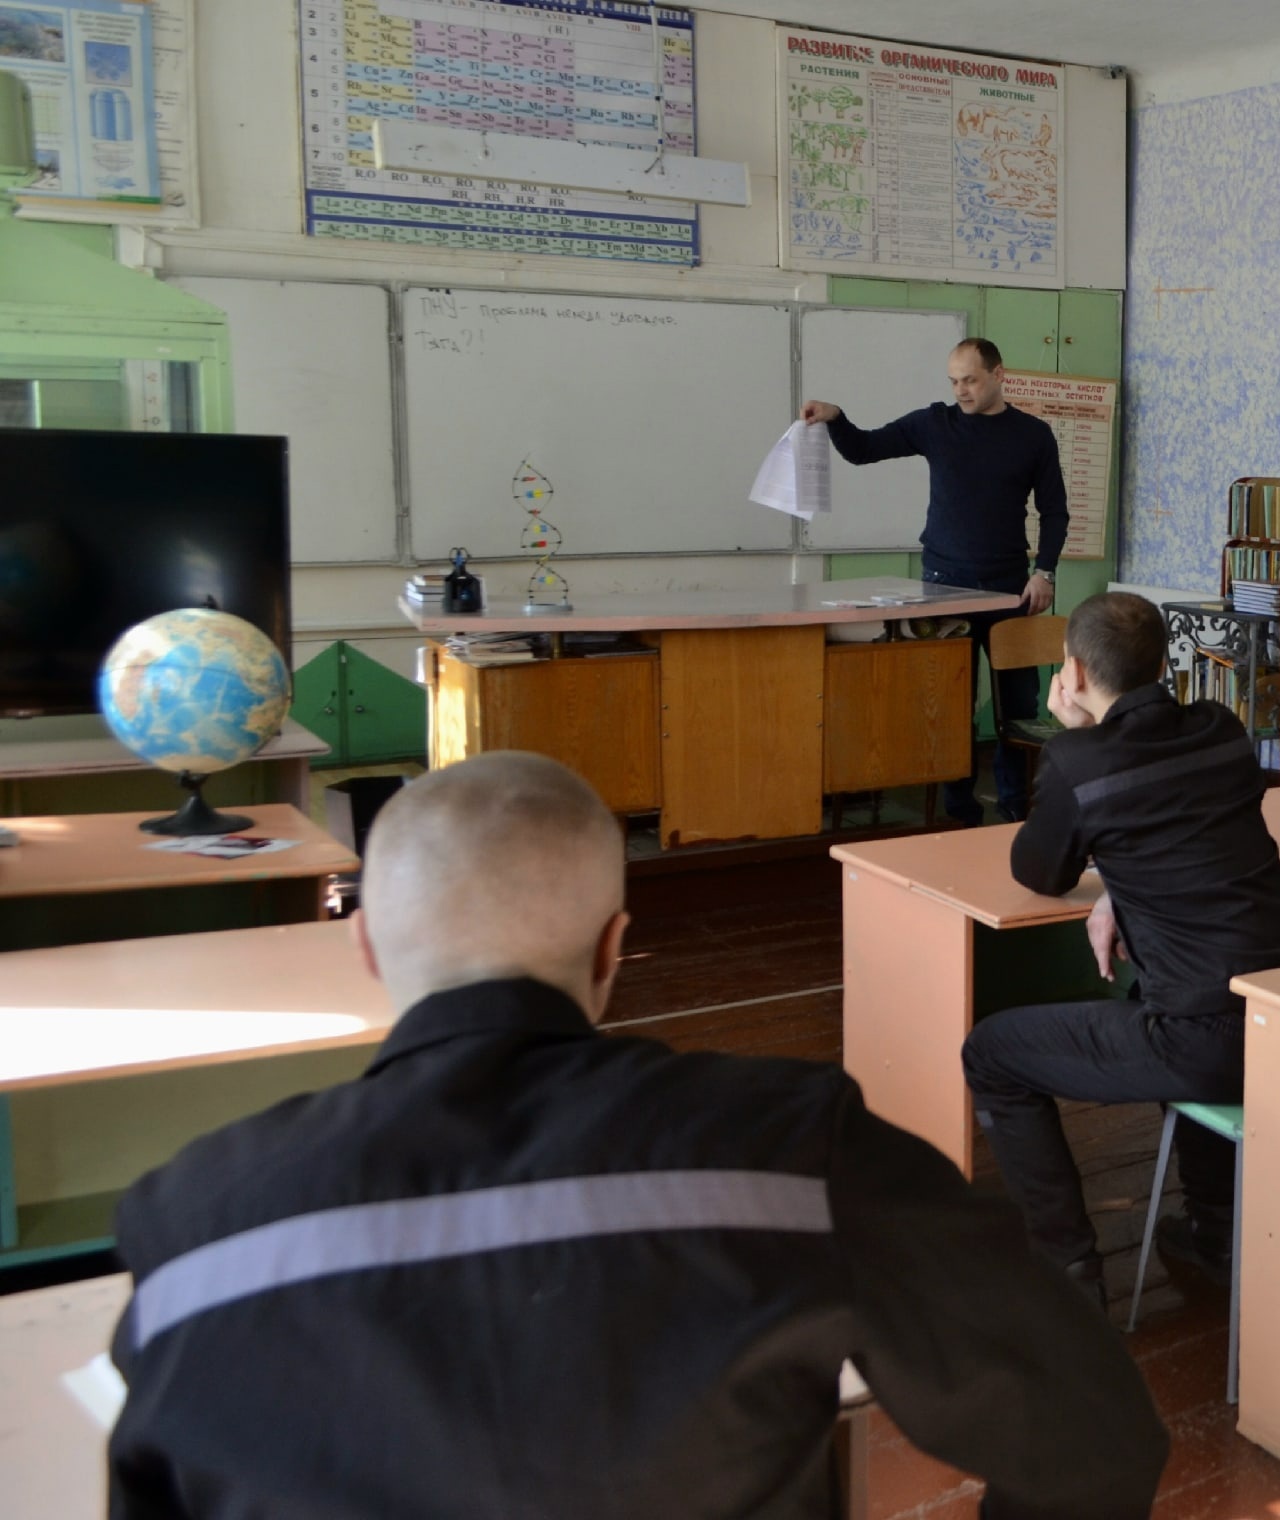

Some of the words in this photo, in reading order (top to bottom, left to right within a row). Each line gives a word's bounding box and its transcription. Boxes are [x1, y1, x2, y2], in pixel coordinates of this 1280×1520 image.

[800, 64, 859, 79] РАСТЕНИЯ
[880, 49, 1009, 82] ОРГАНИЧЕСКОГО
[1016, 68, 1057, 89] МИРА
[899, 73, 950, 85] ОСНОВНЫЕ
[980, 87, 1035, 102] ЖИВОТНЫЕ
